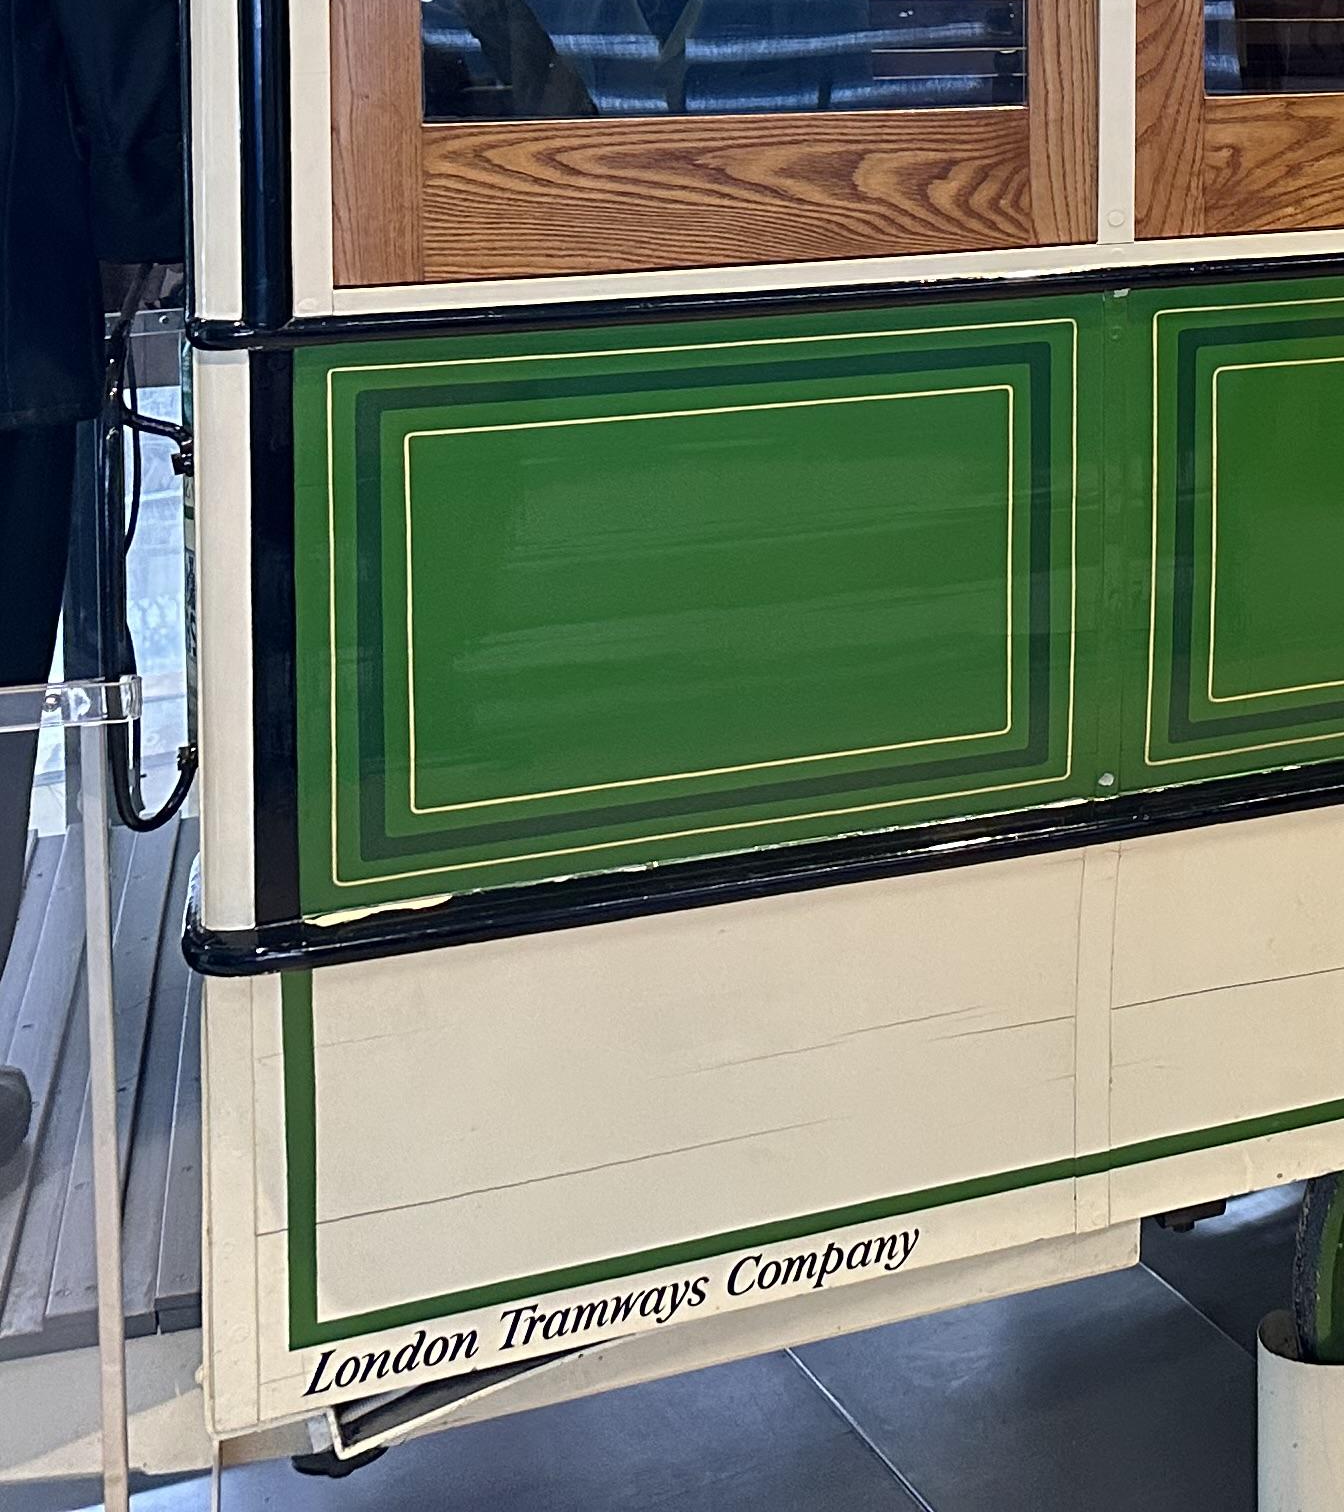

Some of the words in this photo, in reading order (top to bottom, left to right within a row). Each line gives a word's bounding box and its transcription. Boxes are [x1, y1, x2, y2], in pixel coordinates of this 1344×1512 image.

[303, 1330, 480, 1397] London
[497, 1274, 710, 1351] Tramways
[726, 1227, 922, 1297] Company
